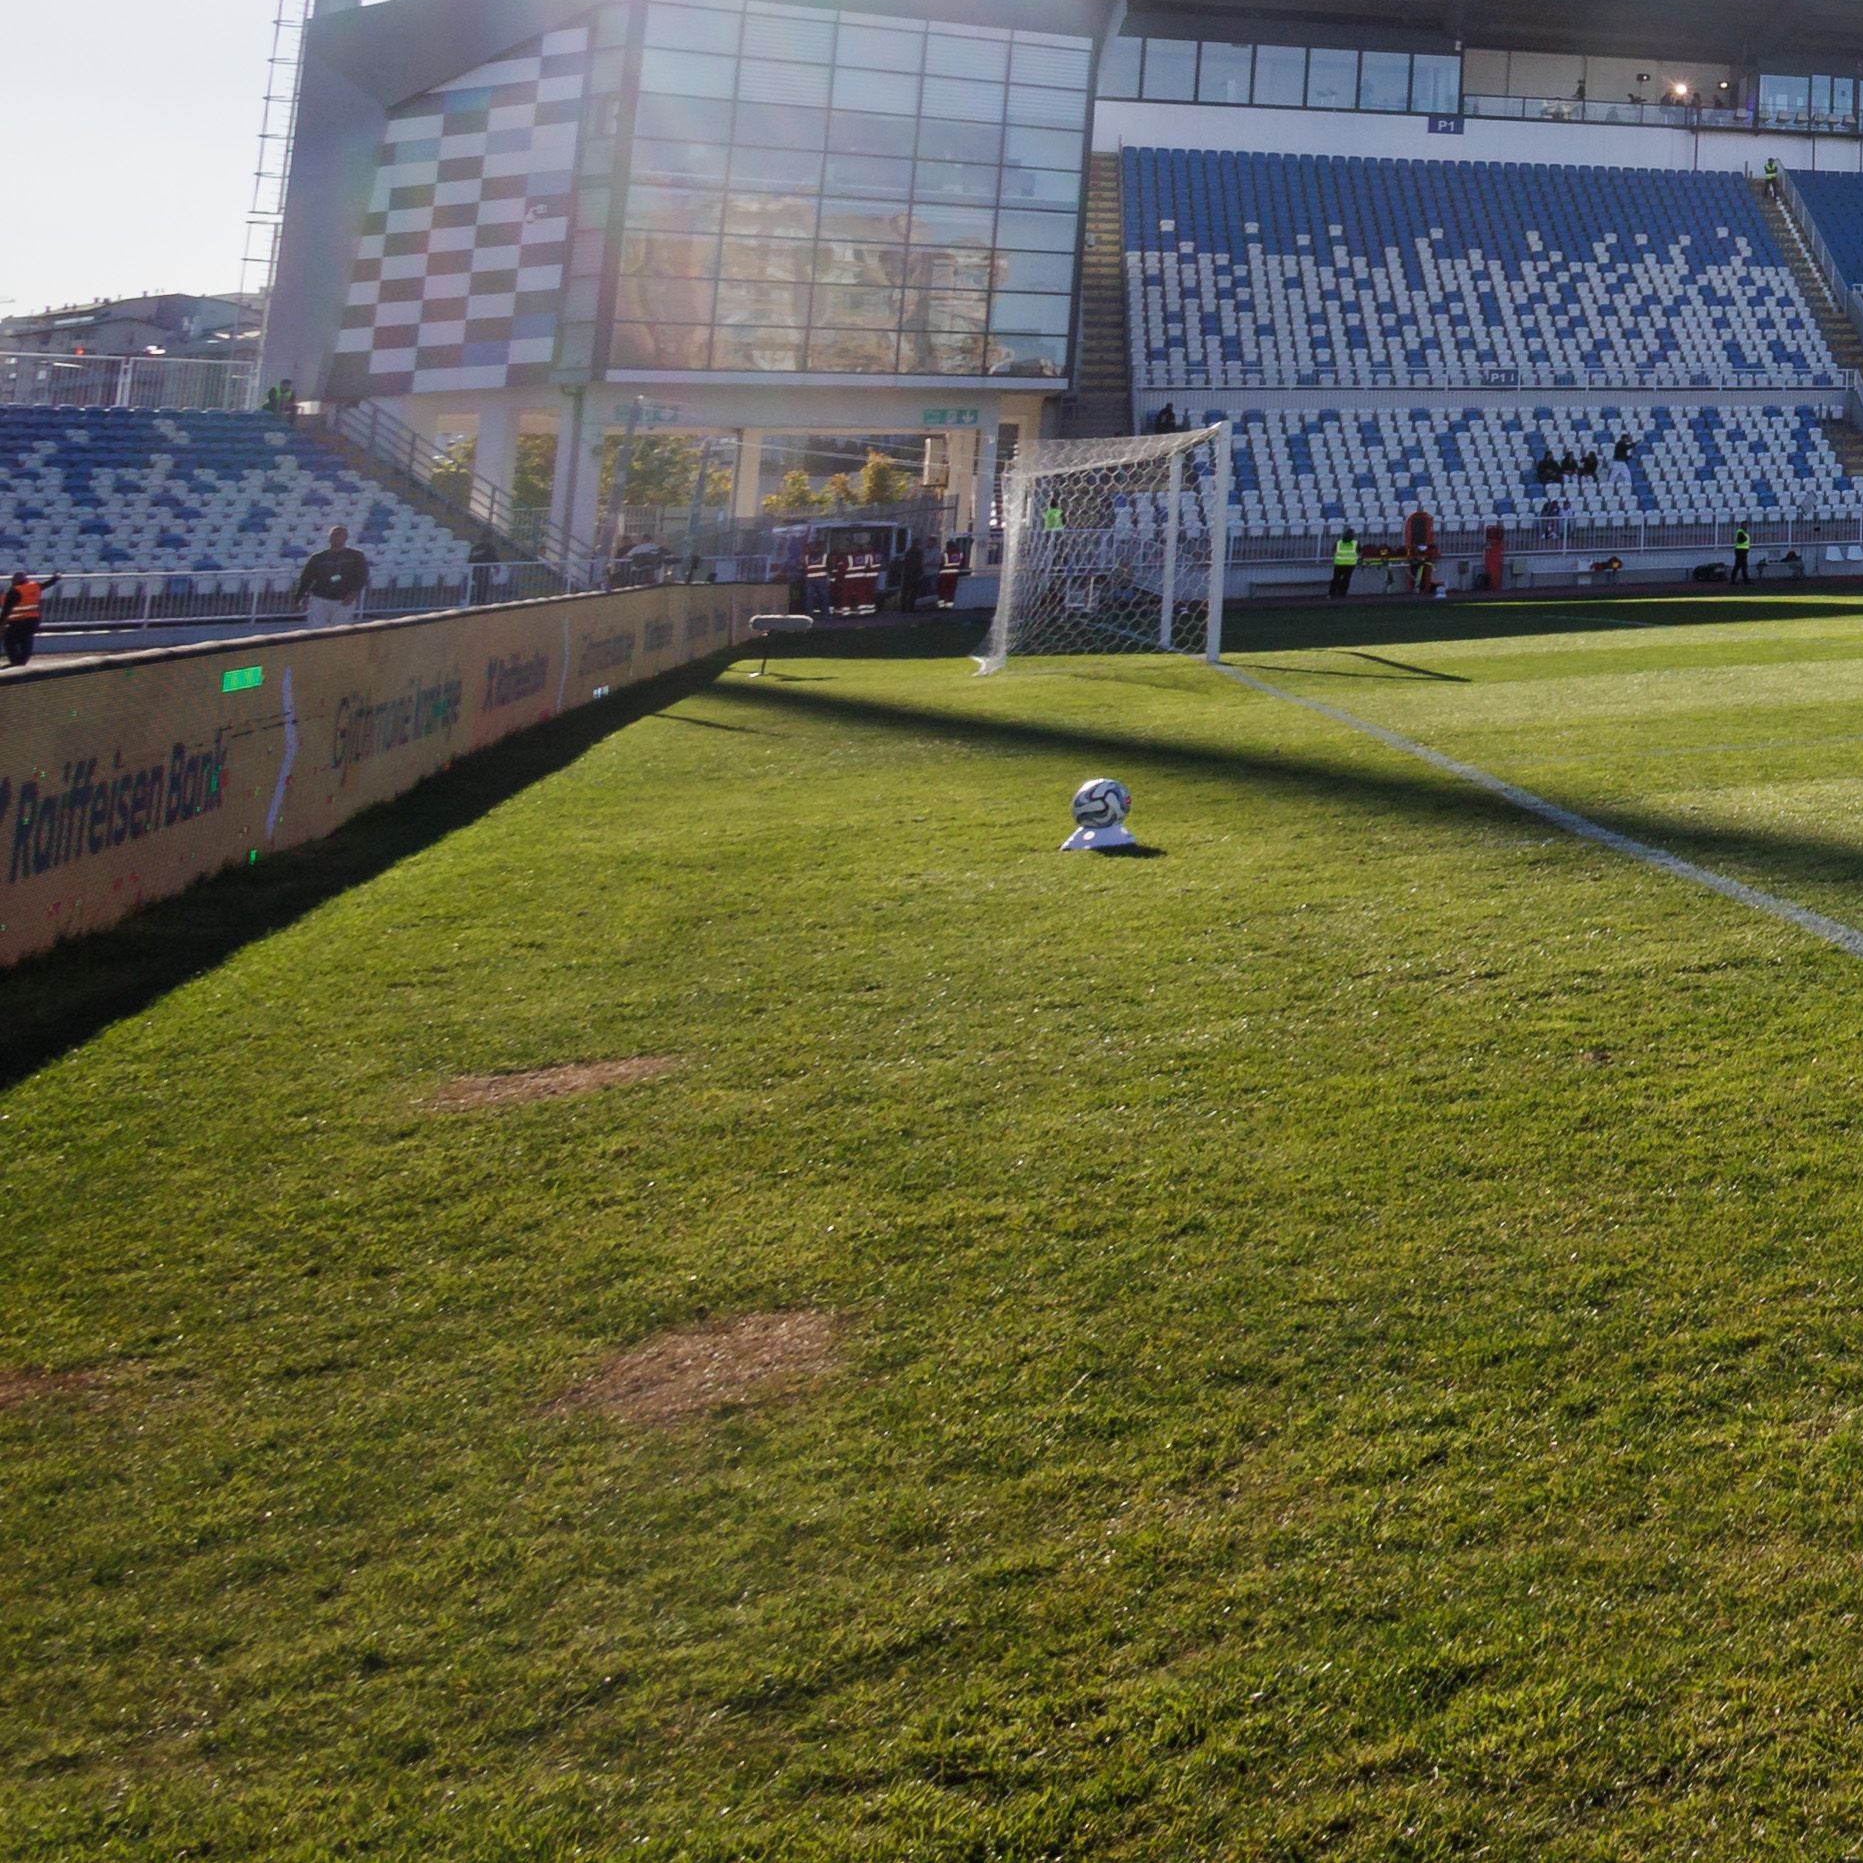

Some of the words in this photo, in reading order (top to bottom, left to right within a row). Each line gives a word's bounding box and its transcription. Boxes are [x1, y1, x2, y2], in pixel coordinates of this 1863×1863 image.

[1438, 120, 1455, 132] P1
[1490, 373, 1505, 382] P1
[9, 749, 164, 885] Raiffeisen
[164, 729, 228, 828] Bank
